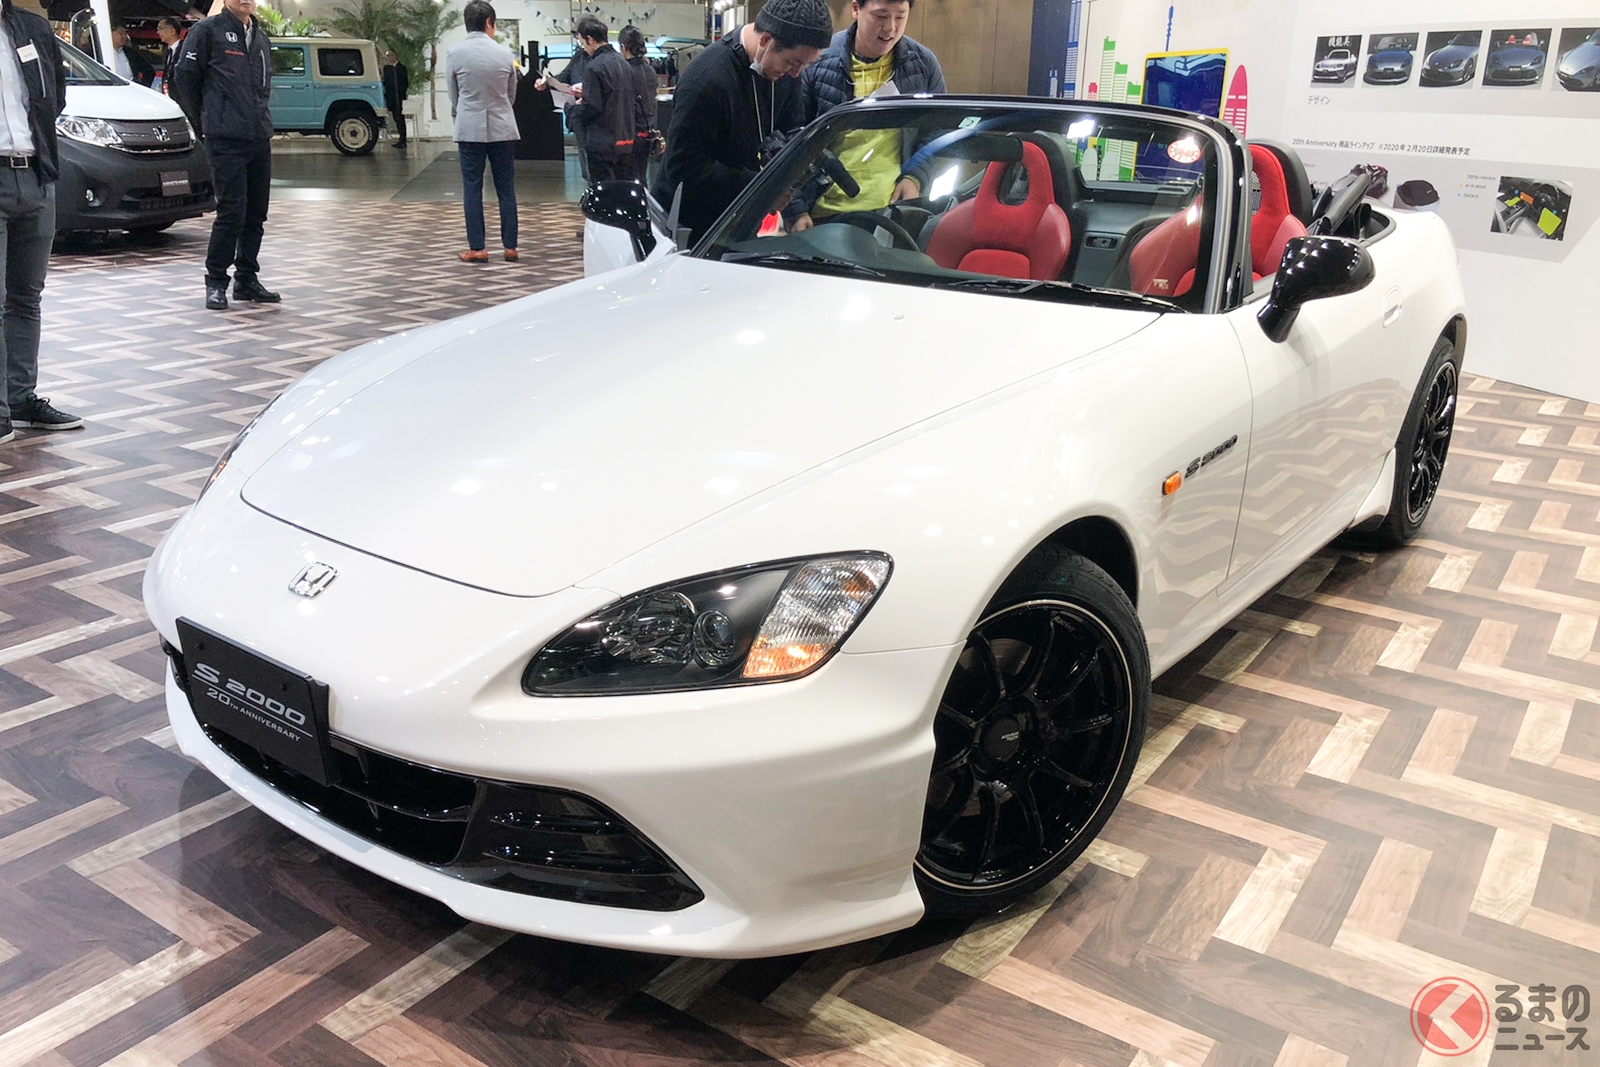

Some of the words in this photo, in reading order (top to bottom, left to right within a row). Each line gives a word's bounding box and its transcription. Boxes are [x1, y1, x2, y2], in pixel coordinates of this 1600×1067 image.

[1307, 95, 1331, 105] デザイン
[1292, 138, 1305, 146] 20th
[1305, 139, 1337, 148] Anniversary
[240, 707, 301, 742] ANNIVERSARY
